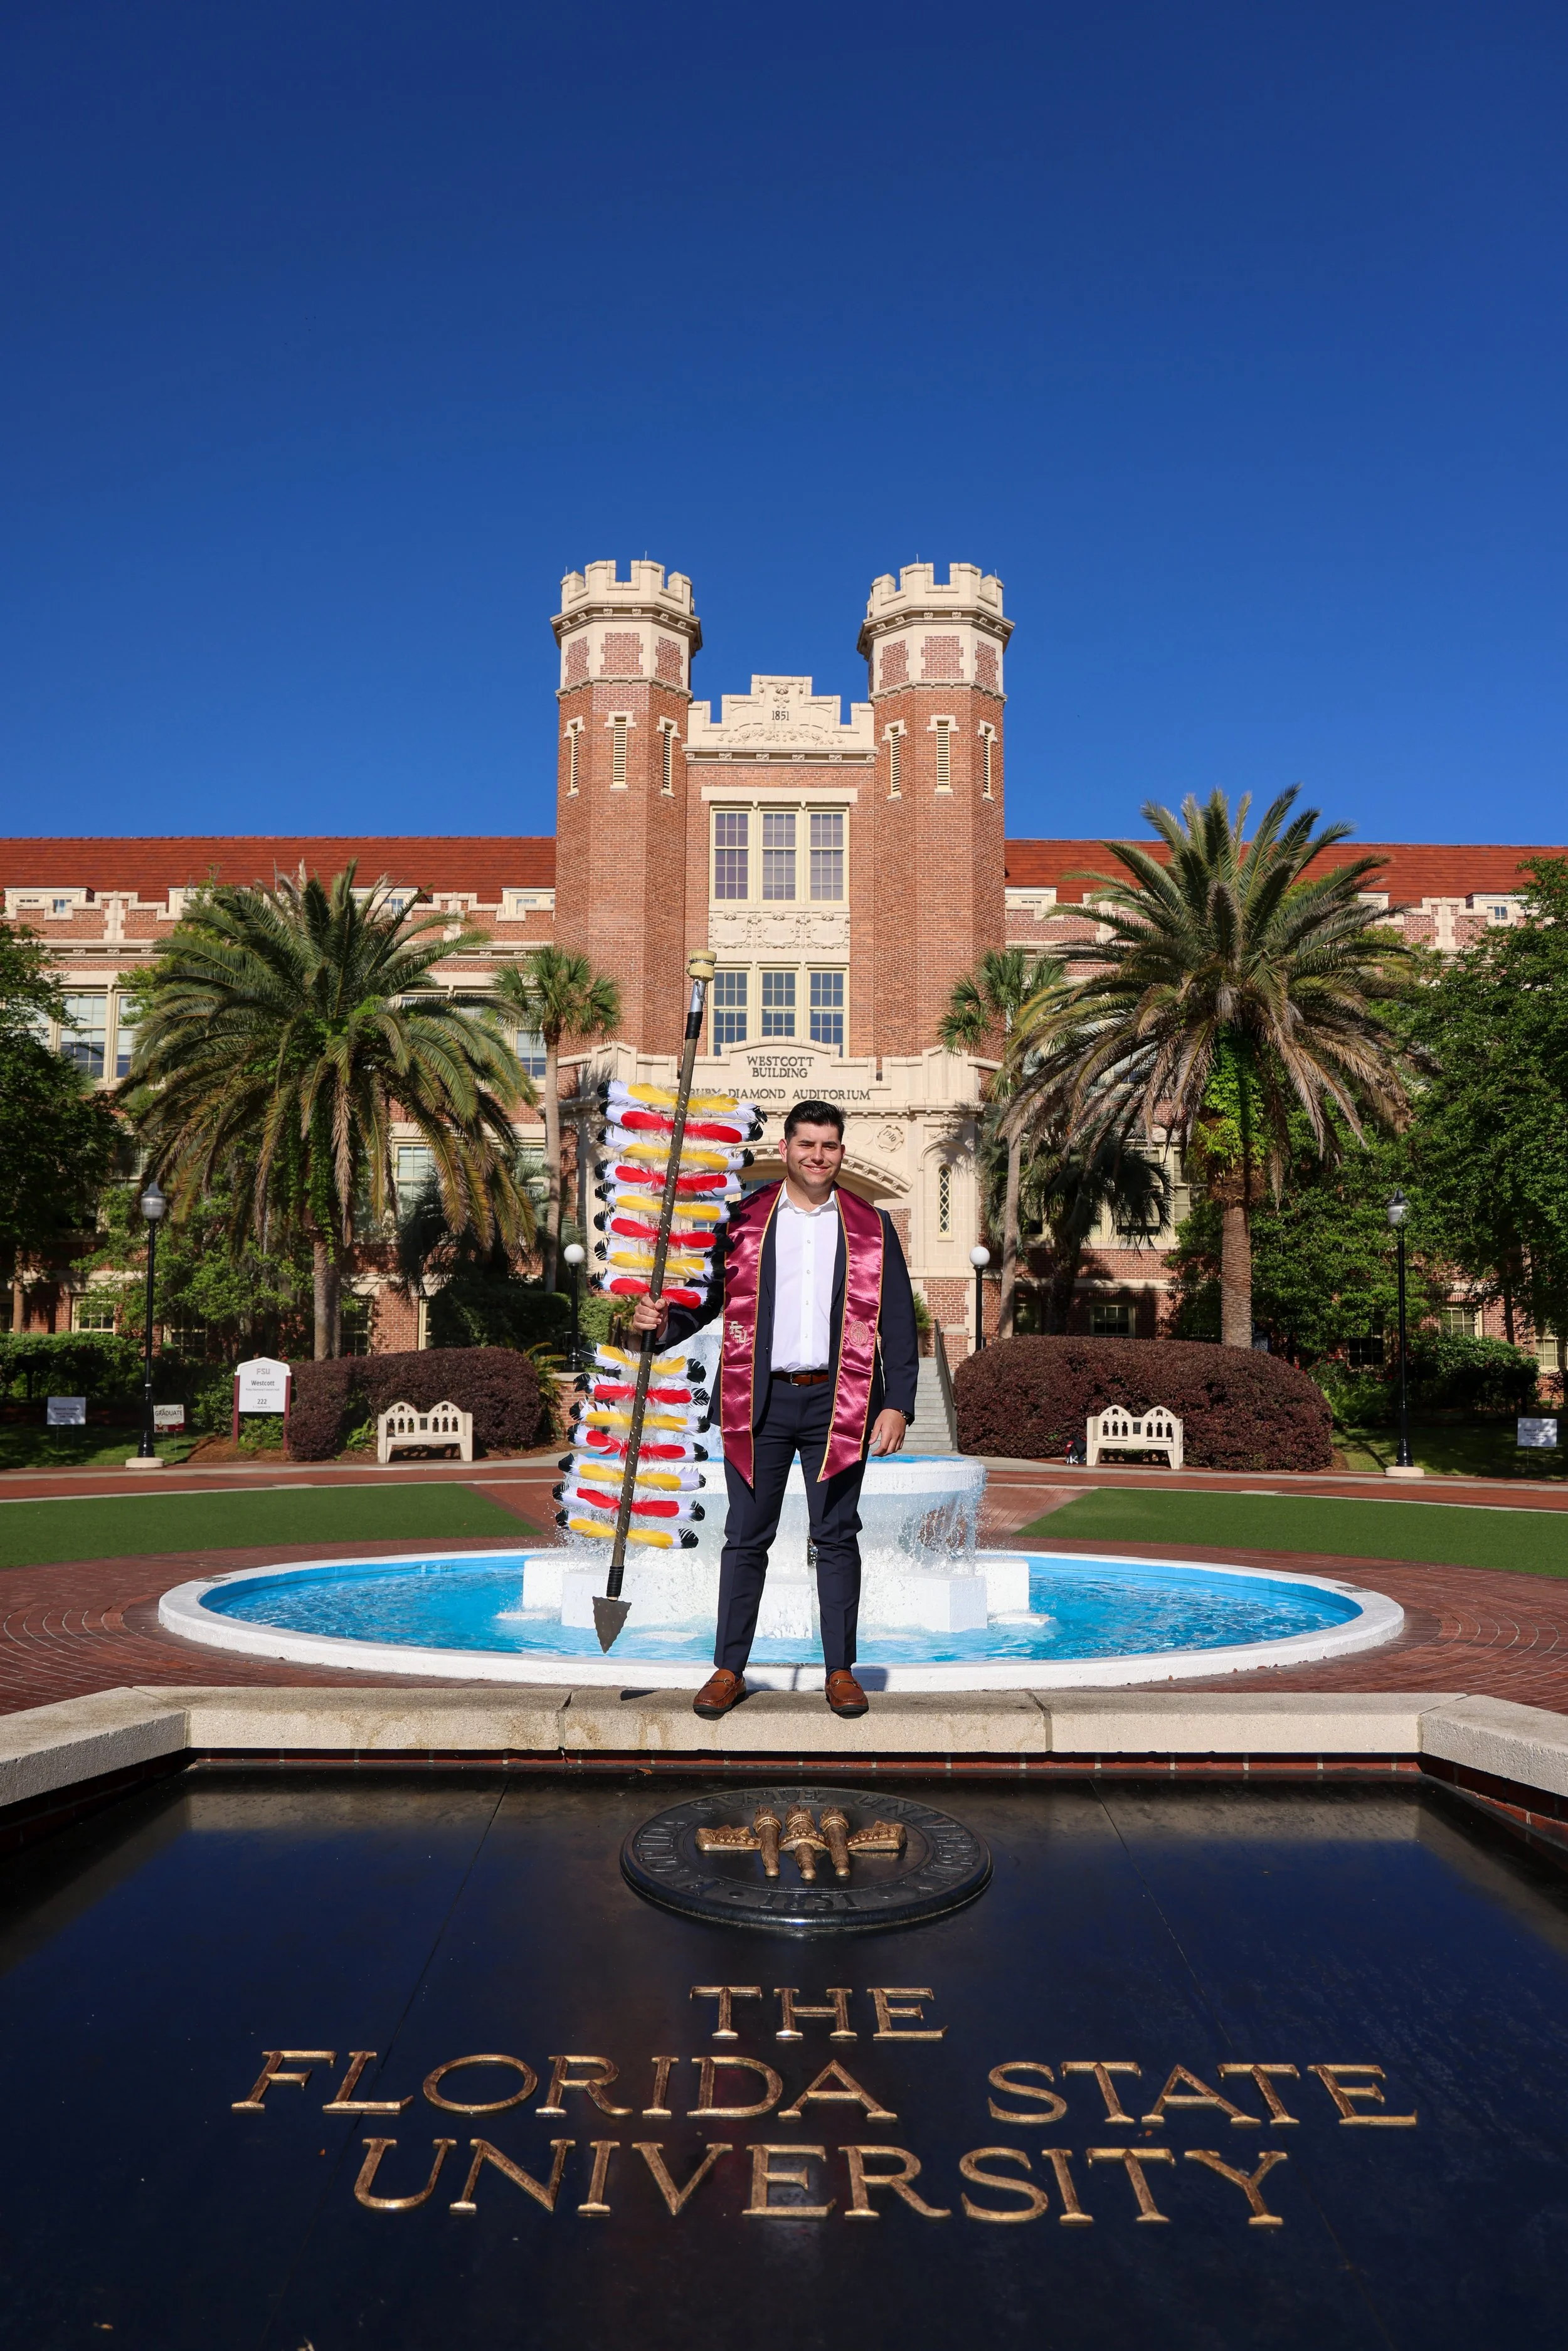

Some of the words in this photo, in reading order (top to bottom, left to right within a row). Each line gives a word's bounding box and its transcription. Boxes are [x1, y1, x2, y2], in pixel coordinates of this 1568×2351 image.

[771, 710, 790, 721] 1851
[746, 1056, 814, 1067] WESTCOTT
[752, 1067, 808, 1078] BUILDING
[728, 1088, 786, 1099] DIAMOND
[792, 1089, 871, 1100] AUDITORIUM
[882, 1130, 896, 1142] 1910
[729, 1320, 747, 1343] FSU
[760, 1892, 861, 1911] 1851
[689, 1985, 948, 2041] THE
[231, 2049, 898, 2120] FLORIDA
[988, 2061, 1417, 2126] STATE
[354, 2138, 1288, 2226] UNIVERSITY
